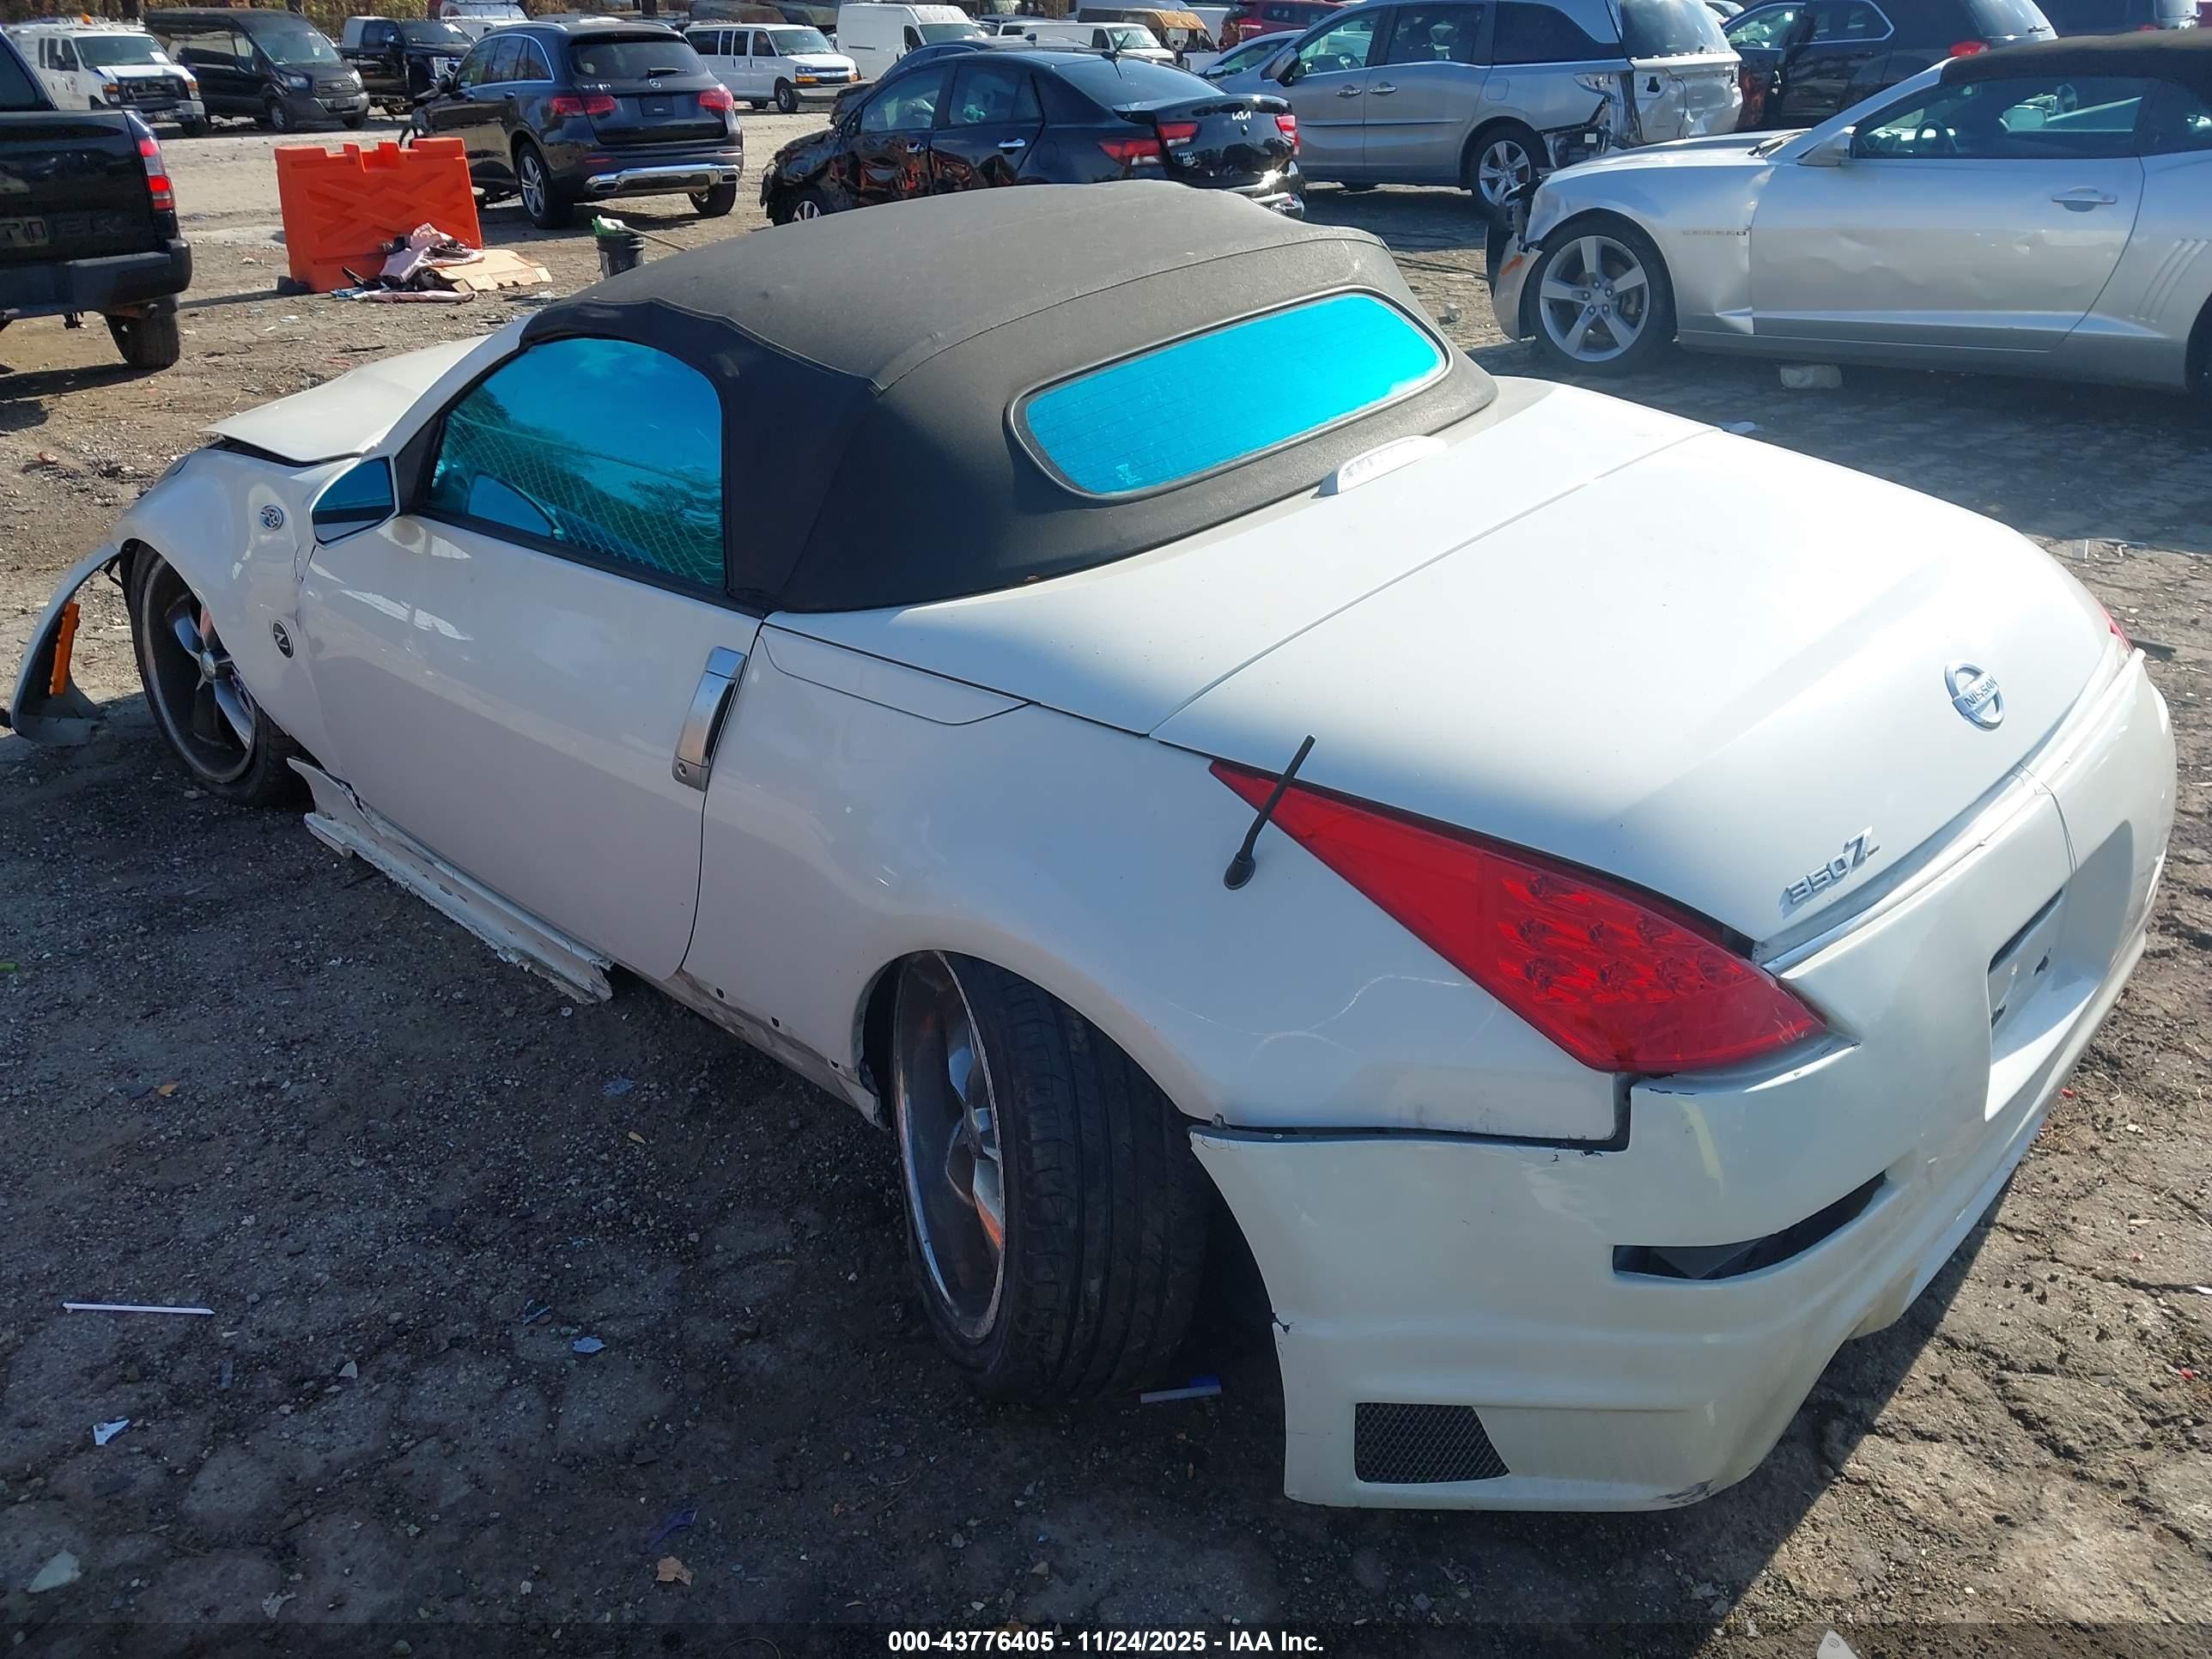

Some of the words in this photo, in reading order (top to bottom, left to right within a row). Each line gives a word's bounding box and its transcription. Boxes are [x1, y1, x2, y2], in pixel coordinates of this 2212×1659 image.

[1231, 110, 1251, 120] KIA
[1964, 673, 1998, 708] NISSAN
[1786, 825, 1880, 904] 350Z
